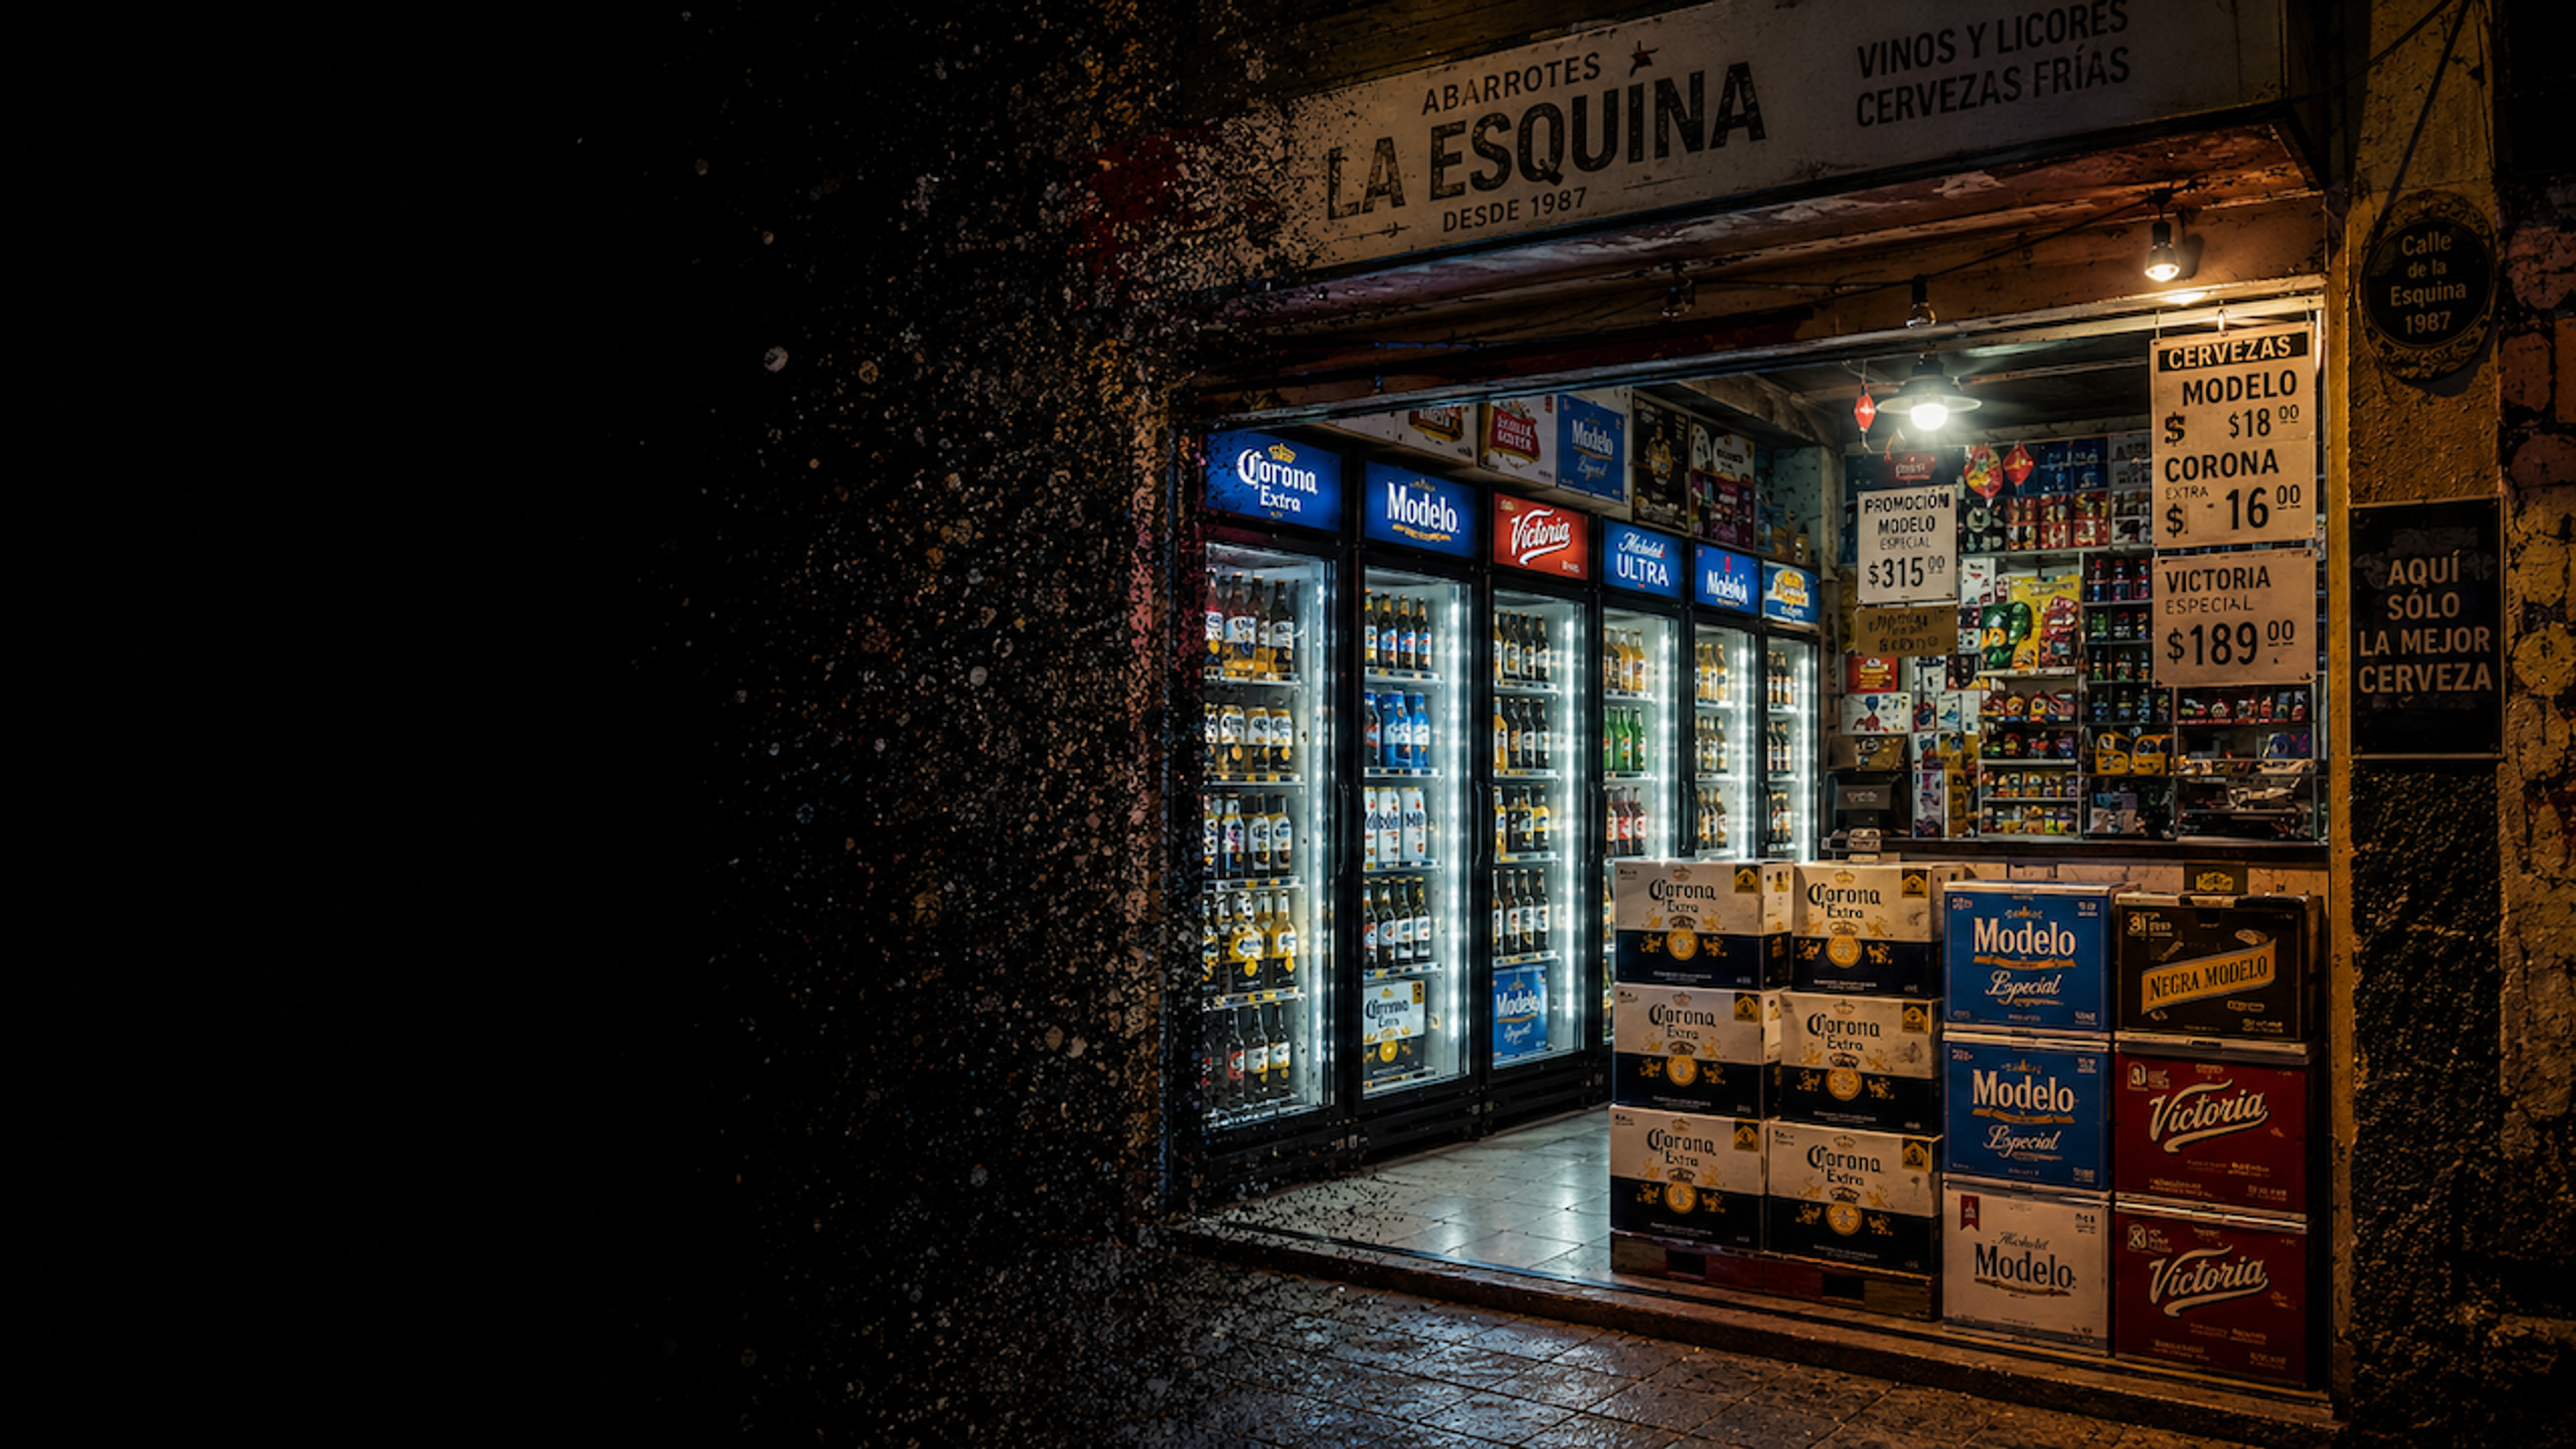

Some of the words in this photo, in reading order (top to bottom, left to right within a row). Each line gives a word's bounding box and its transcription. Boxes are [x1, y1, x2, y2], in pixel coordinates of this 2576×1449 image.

[1858, 28, 1955, 78] VINOS
[1967, 22, 1987, 58] Y
[1997, 0, 2129, 54] LICORES
[1421, 52, 1601, 116] ABARROTES
[1858, 66, 2021, 126] CERVEZAS
[2034, 44, 2130, 97] FRÍAS
[1328, 136, 1405, 220] LA
[1444, 199, 1519, 233] DESDE
[1532, 186, 1587, 217] 1987
[2401, 230, 2453, 257] Calle
[2407, 260, 2427, 279] de
[2431, 258, 2448, 276] la
[2390, 280, 2467, 309] Esquina
[2404, 310, 2451, 335] 1987
[2168, 335, 2292, 370] CERVEZAS
[2183, 370, 2296, 406] MODELO
[2165, 412, 2185, 447] $
[2229, 408, 2271, 439] $18
[2279, 404, 2300, 421] 00
[1237, 448, 1319, 496] Corona
[2165, 449, 2279, 482] CORONA
[1260, 486, 1301, 513] Extra
[1386, 482, 1458, 533] Modelo
[1865, 492, 1949, 515] PROMOCIÓN
[2165, 486, 2209, 500] EXTRA
[1878, 516, 1935, 535] MODELO
[2165, 503, 2184, 538] $
[2226, 487, 2269, 530] 16
[2276, 484, 2301, 505] 00
[1511, 508, 1571, 566] Victoria
[1880, 537, 1931, 551] ESPECIAL
[1617, 553, 1669, 586] ULTRA
[1868, 557, 1923, 588] $315
[1928, 555, 1945, 570] 00
[2165, 566, 2271, 593] VICTORIA
[2387, 549, 2461, 588] AQUÍ
[2165, 595, 2255, 614] ESPECIAL
[2387, 588, 2461, 621] SÓLO
[2167, 622, 2257, 665] $189
[2267, 620, 2294, 641] 00
[2359, 629, 2392, 657] LA
[2400, 626, 2491, 655] MEJOR
[2359, 661, 2493, 694] CERVEZA
[1649, 878, 1717, 904] Corona
[1666, 901, 1699, 914] Extra
[1807, 881, 1882, 908] Corona
[1827, 905, 1864, 920] Extra
[1974, 916, 2078, 957] Modelo
[1984, 969, 2063, 1005] Especial
[2149, 971, 2199, 1002] NEGRA
[2204, 956, 2268, 989] MODELO
[1648, 1004, 1717, 1029] Corona
[1666, 1025, 1699, 1040] Extra
[1807, 1012, 1881, 1039] Corona
[1827, 1036, 1864, 1052] Extra
[1972, 1068, 2076, 1114] Modelo
[2149, 1078, 2271, 1153] Victoria
[1648, 1127, 1717, 1157] Corona
[1982, 1124, 2063, 1159] Especial
[1665, 1150, 1699, 1168] Extra
[1807, 1144, 1882, 1173] Corona
[1827, 1168, 1864, 1187] Extra
[1975, 1242, 2072, 1289] Modelo
[2149, 1244, 2271, 1318] Victoria
